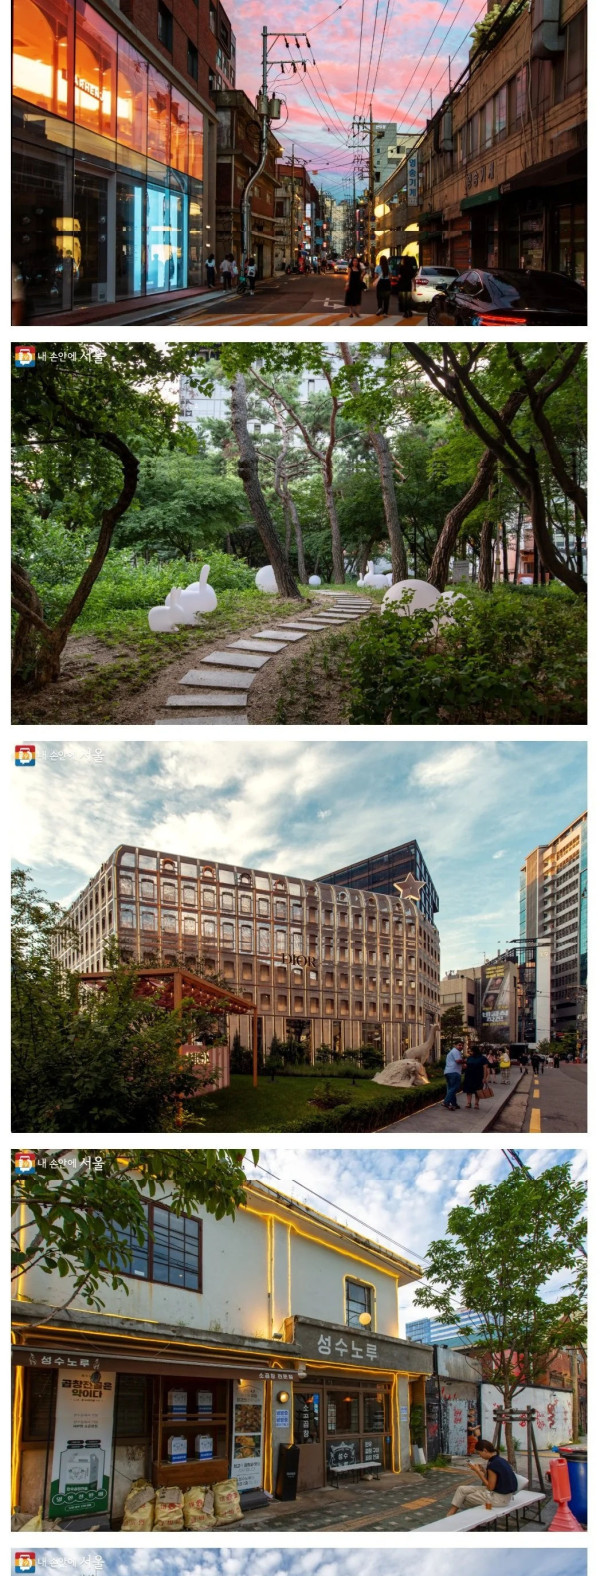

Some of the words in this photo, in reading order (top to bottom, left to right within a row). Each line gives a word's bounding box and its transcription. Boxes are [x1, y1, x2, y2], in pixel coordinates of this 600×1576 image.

[281, 953, 316, 968] DIOR
[317, 1334, 377, 1360] 성수노루
[41, 1356, 90, 1367] 성수노루
[72, 1389, 103, 1398] 약이다
